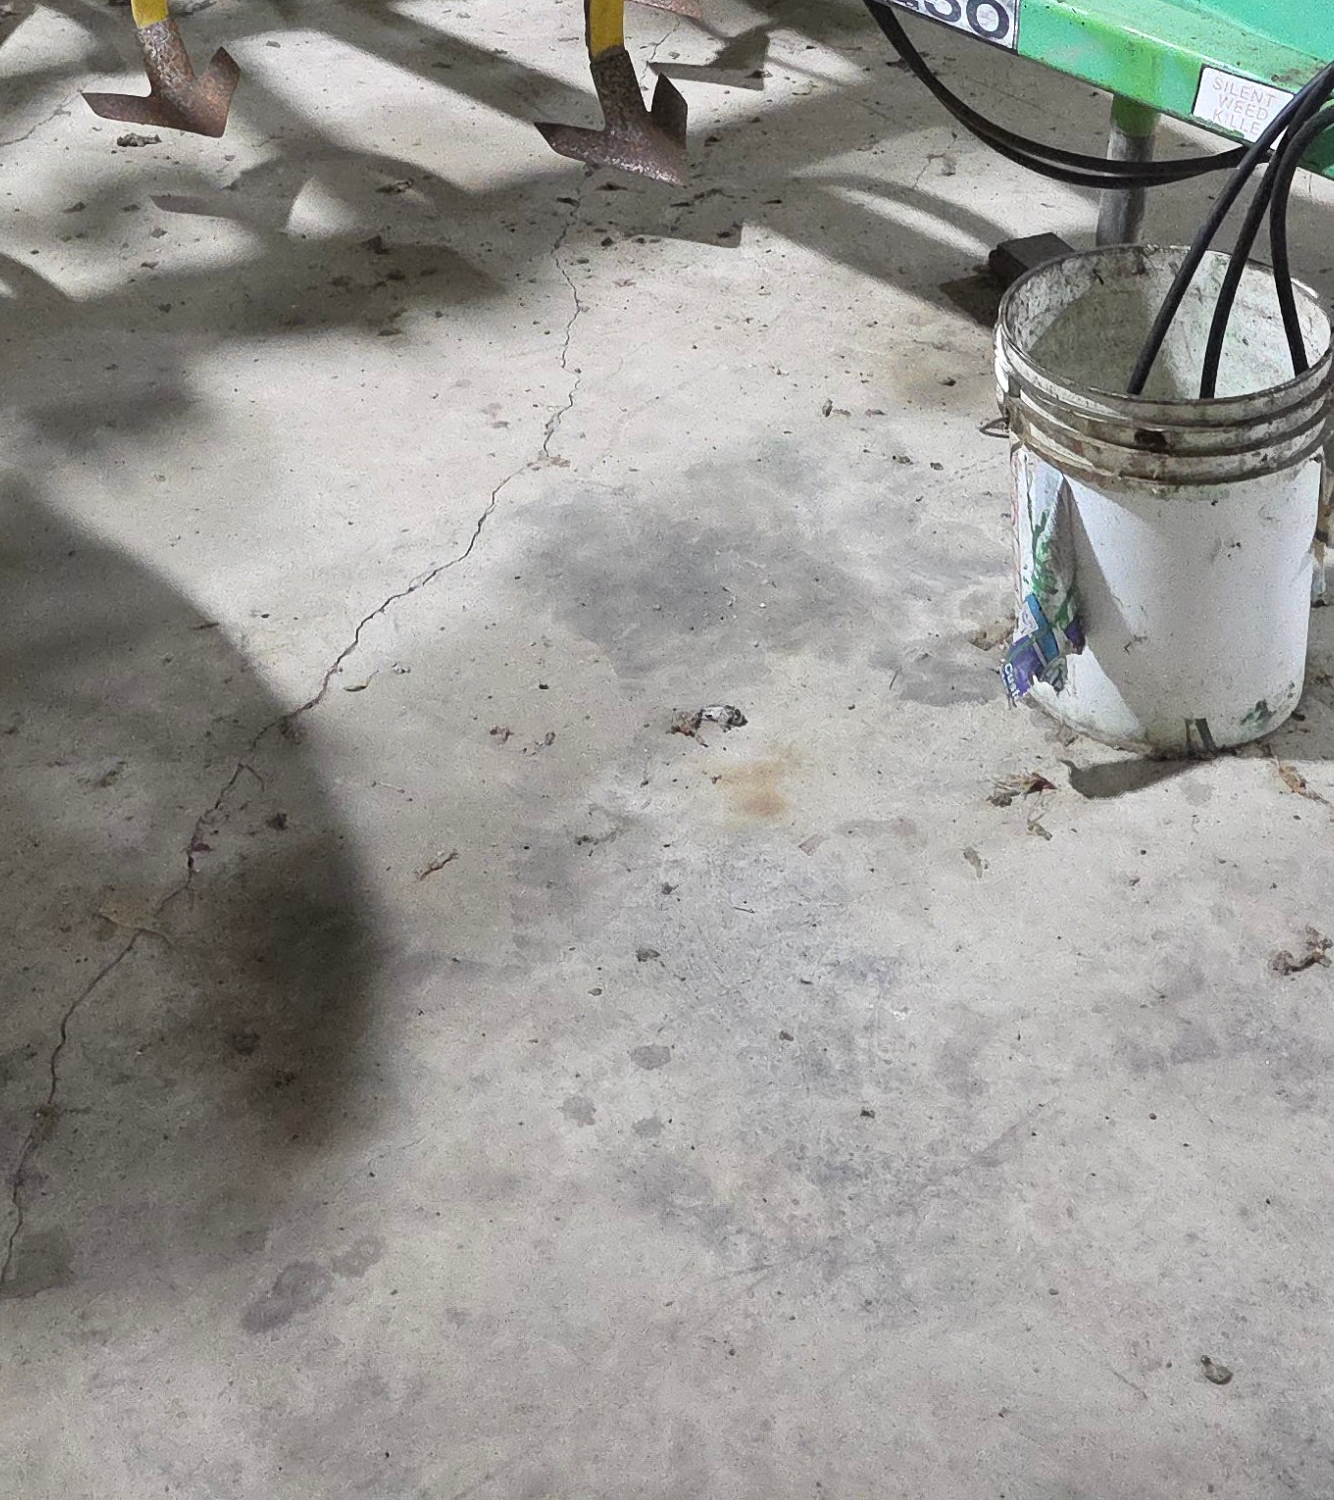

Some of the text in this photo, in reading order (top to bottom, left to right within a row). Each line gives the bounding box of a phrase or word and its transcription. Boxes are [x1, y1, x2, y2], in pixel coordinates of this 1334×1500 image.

[1213, 77, 1276, 108] SILENT
[1219, 94, 1268, 121] WEED
[1213, 108, 1261, 135] KILLE
